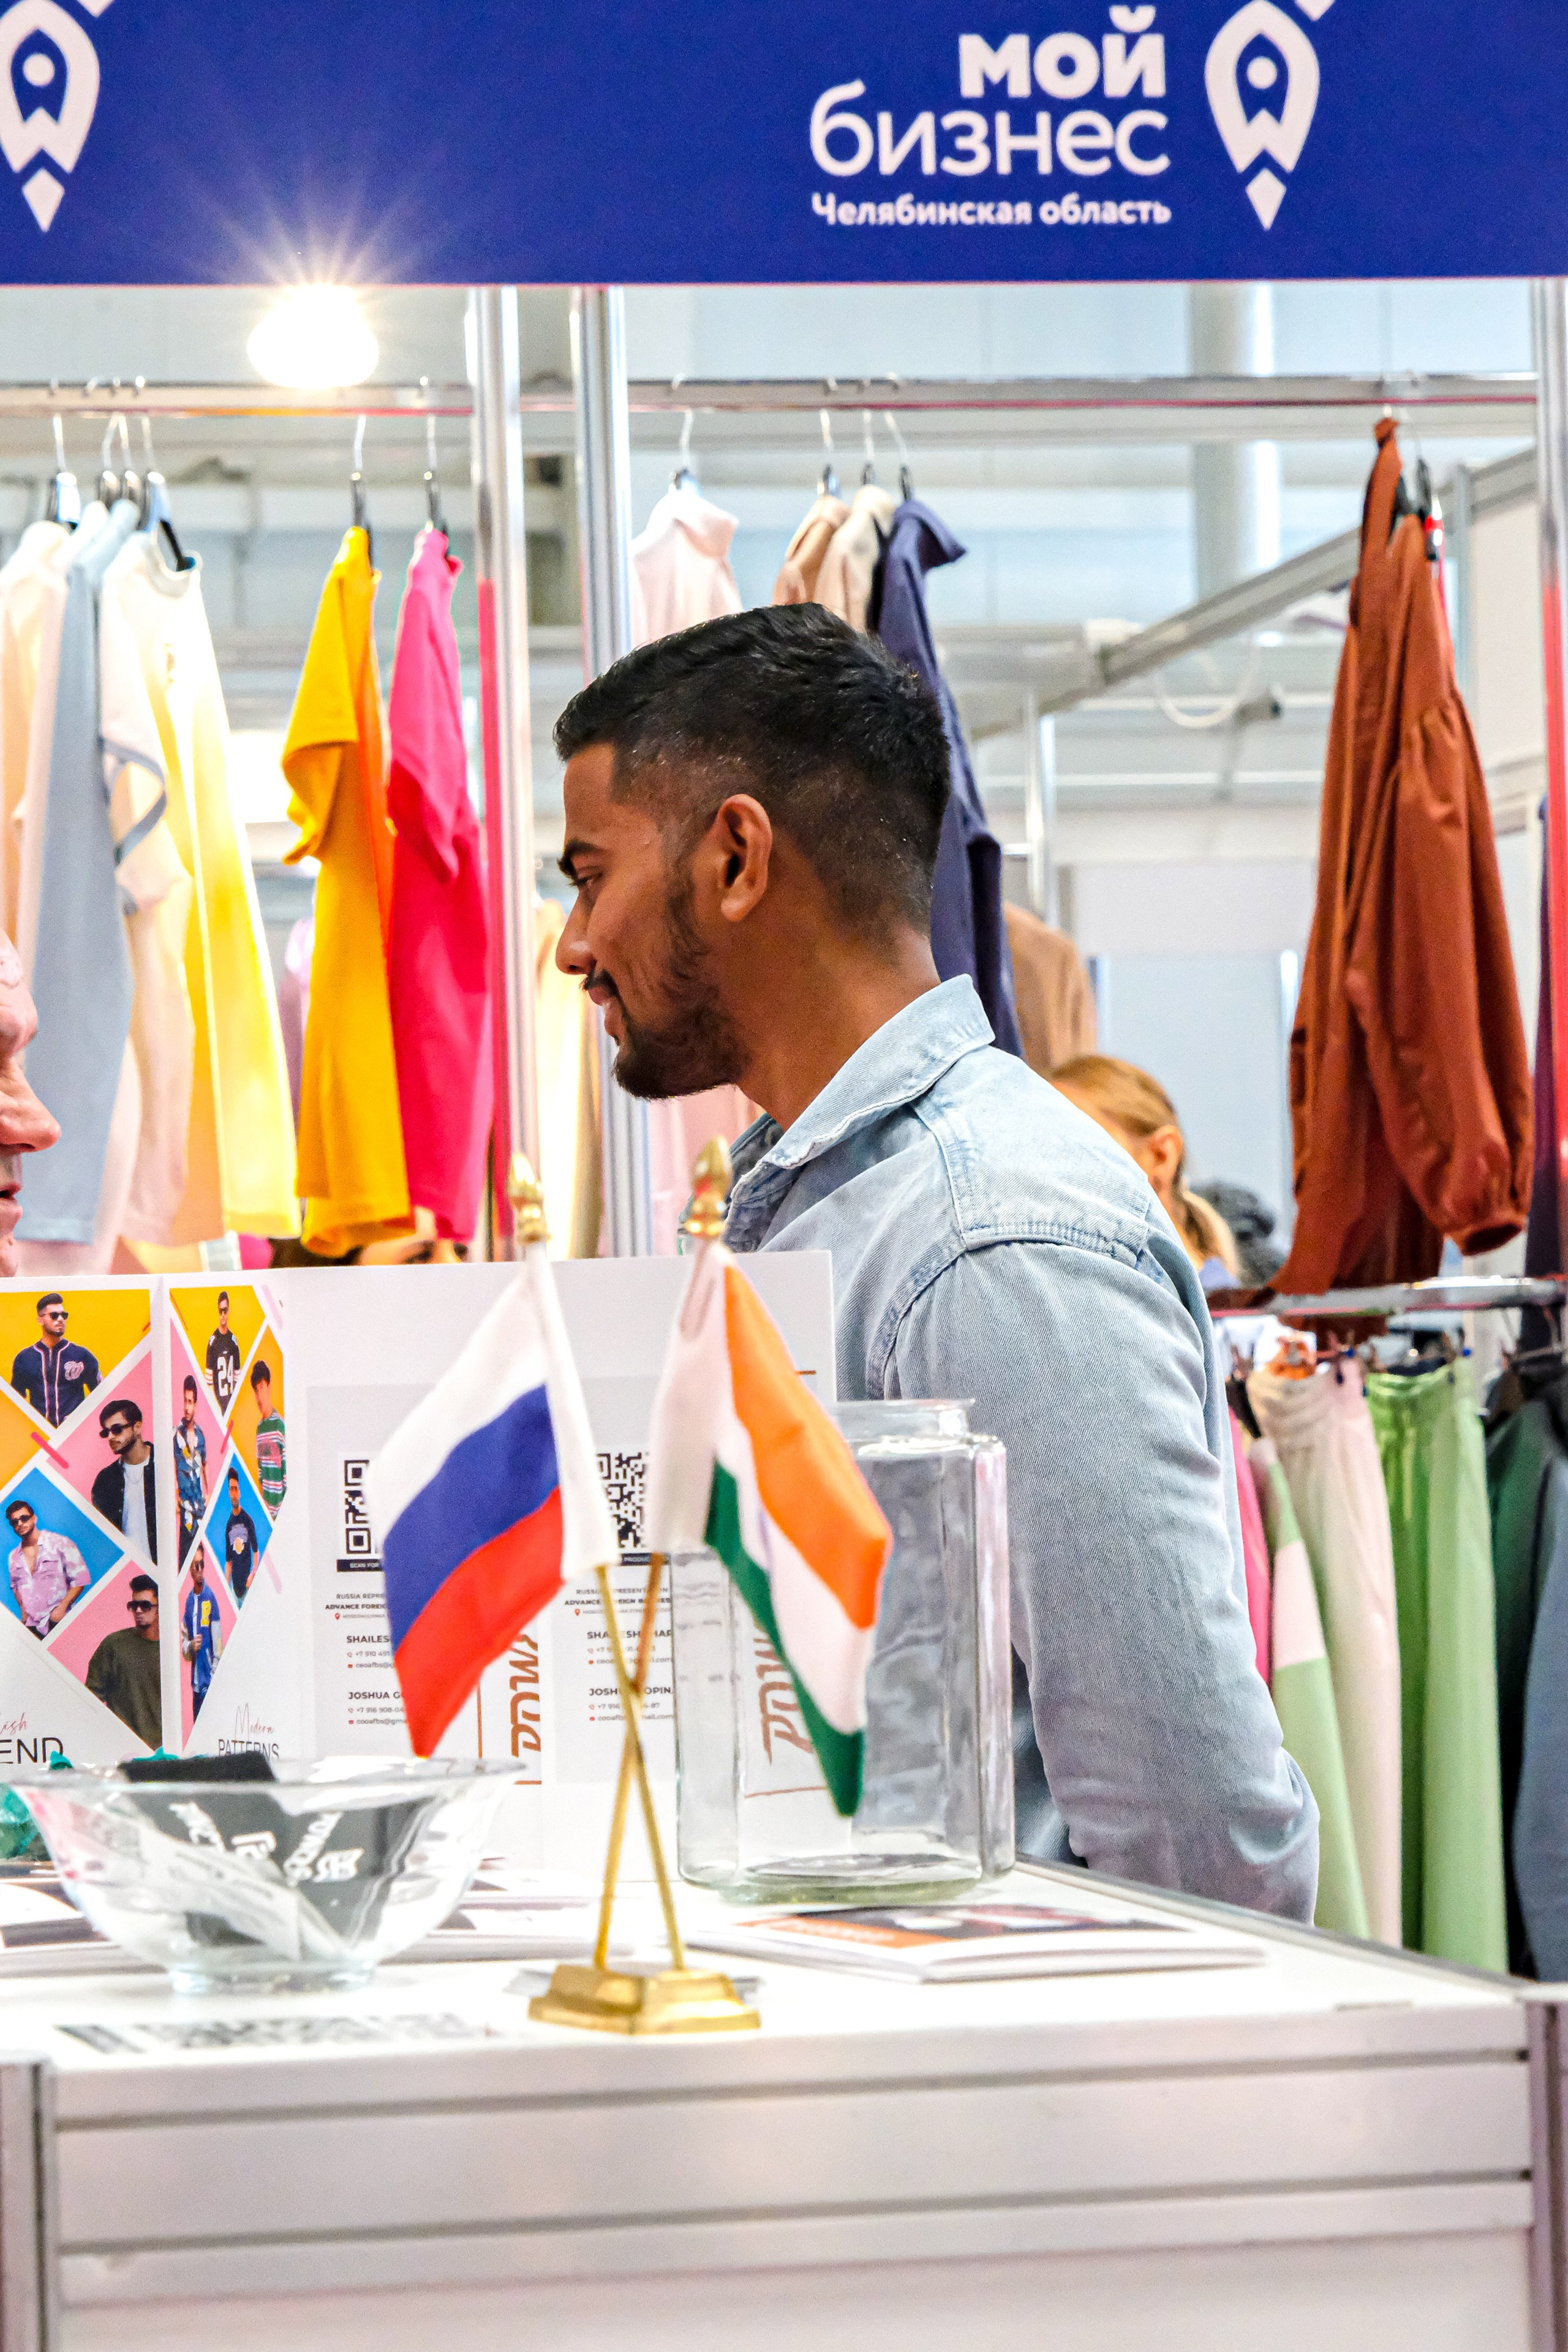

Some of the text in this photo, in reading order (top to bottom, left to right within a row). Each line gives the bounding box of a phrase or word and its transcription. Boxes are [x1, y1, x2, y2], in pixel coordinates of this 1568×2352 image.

[959, 5, 1166, 99] мой
[810, 79, 1170, 176] бизнес
[812, 192, 1172, 225] Челябинская область
